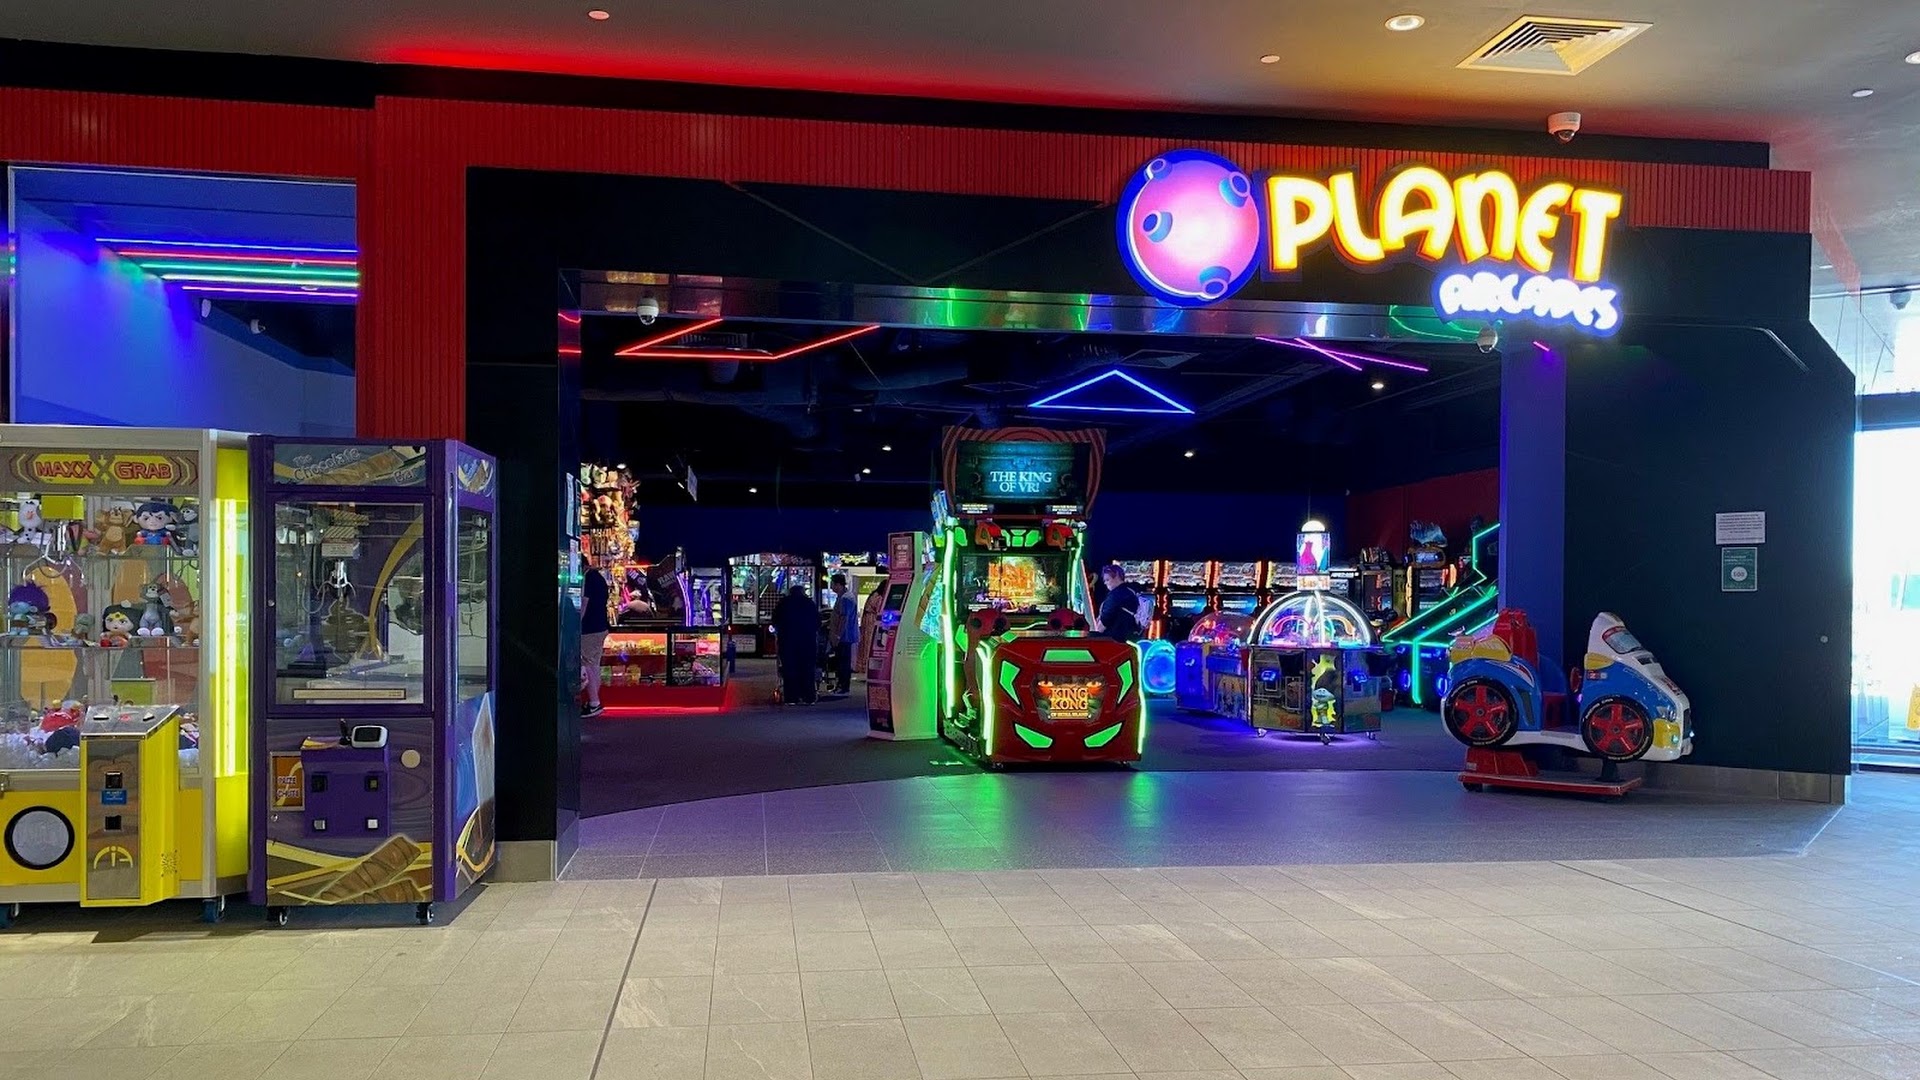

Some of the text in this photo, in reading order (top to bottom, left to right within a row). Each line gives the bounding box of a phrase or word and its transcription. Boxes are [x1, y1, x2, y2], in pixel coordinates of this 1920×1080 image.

[1268, 166, 1622, 282] PLANET
[35, 461, 173, 480] MAXX GRAB
[294, 448, 361, 481] Chocolate
[990, 471, 1052, 483] THE KING
[1000, 482, 1039, 492] OF VR!
[1051, 687, 1088, 700] KING
[1050, 699, 1088, 710] KONG
